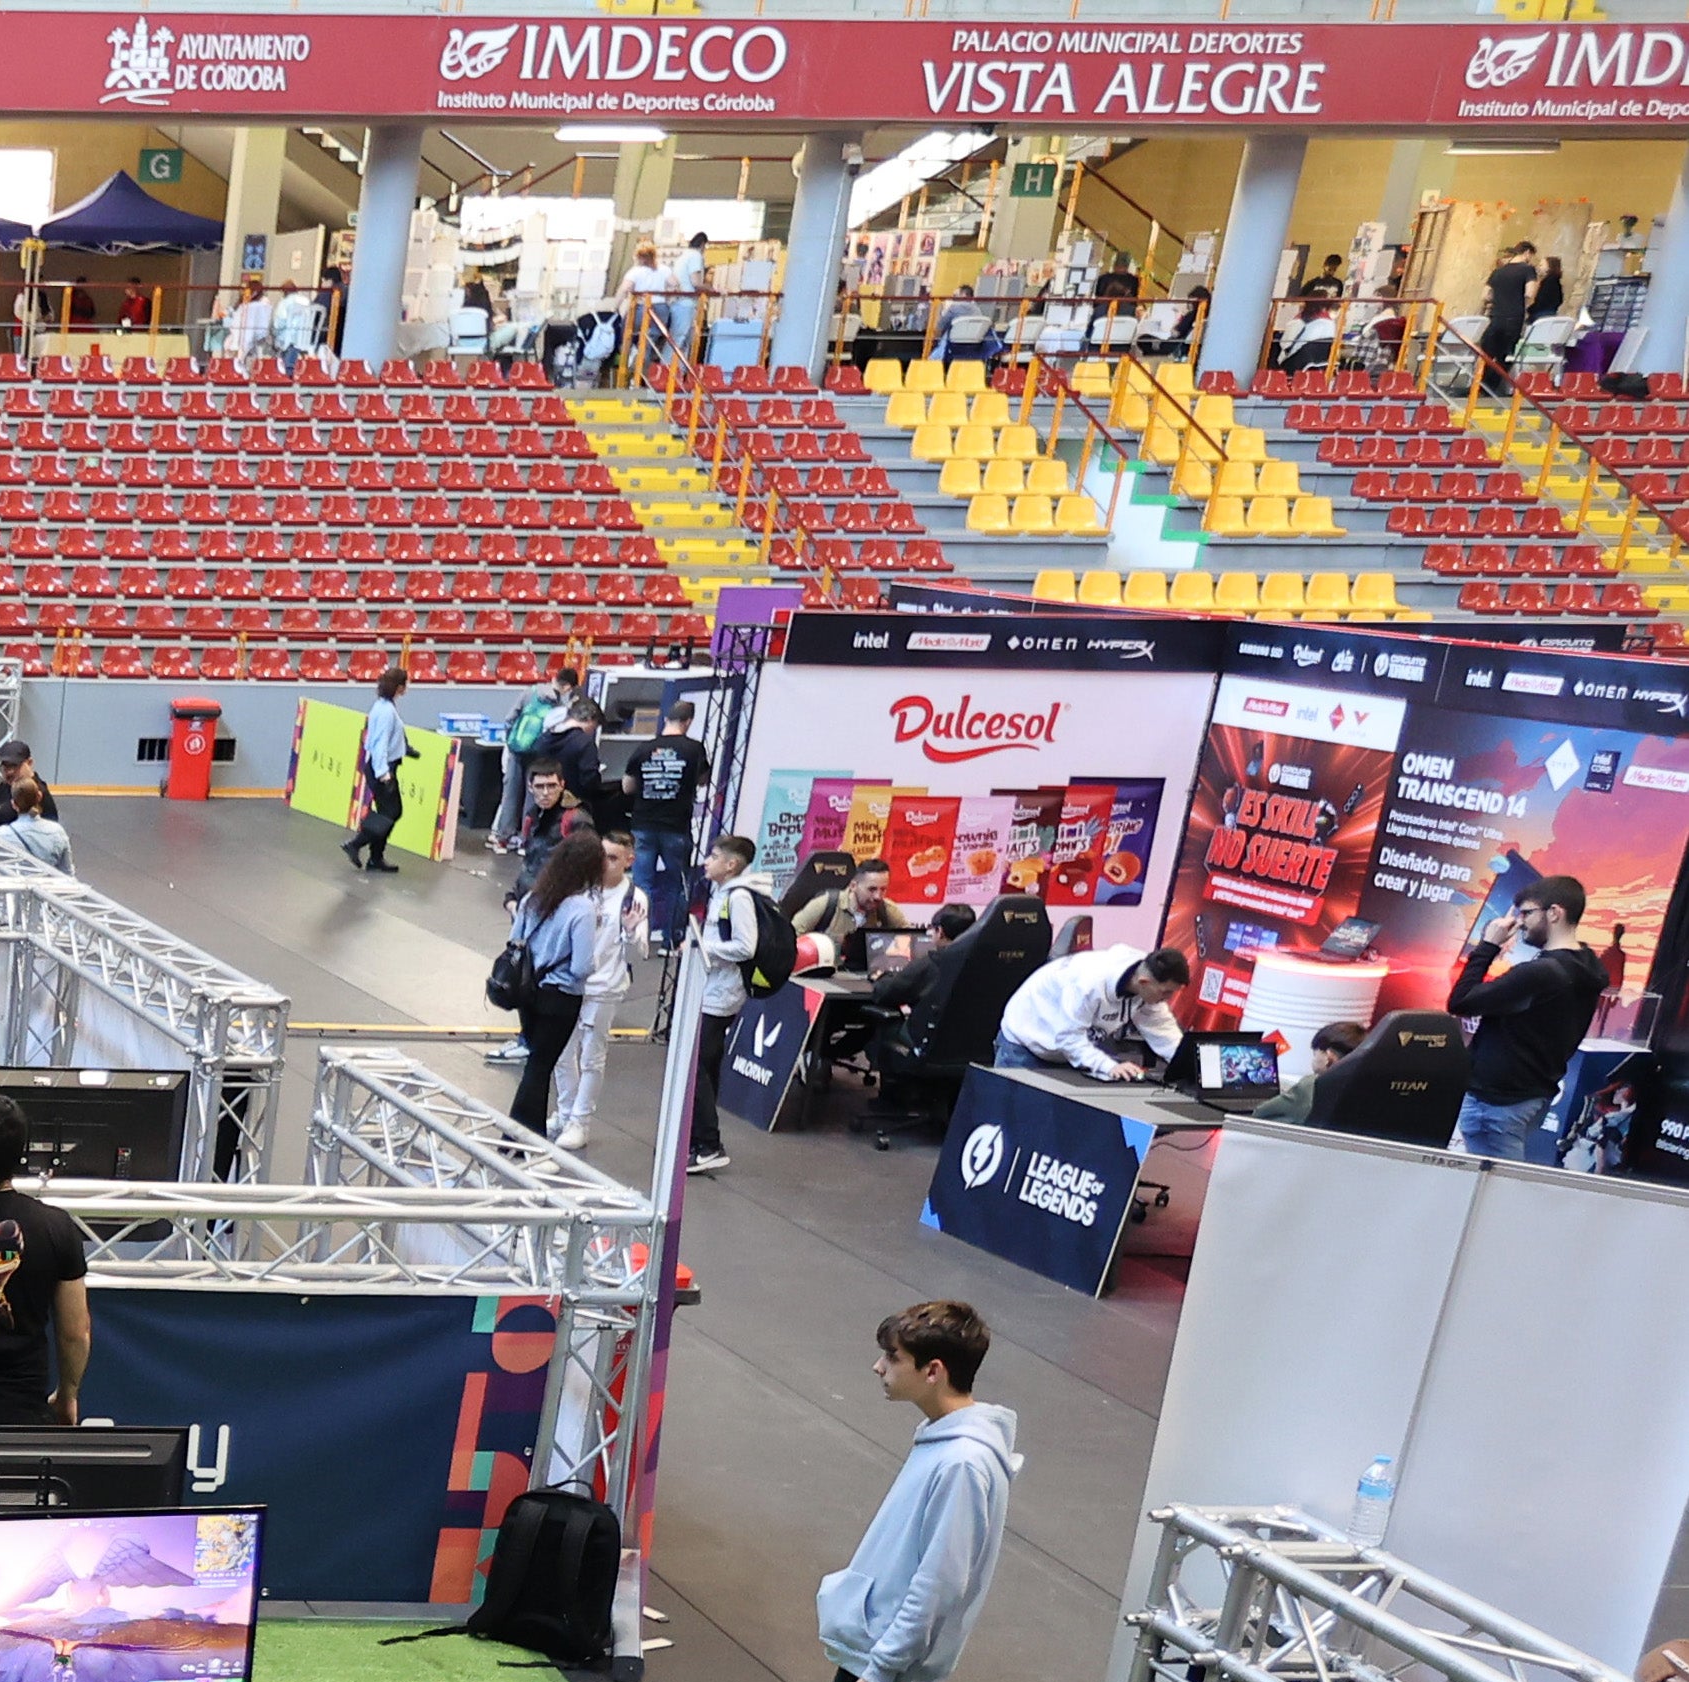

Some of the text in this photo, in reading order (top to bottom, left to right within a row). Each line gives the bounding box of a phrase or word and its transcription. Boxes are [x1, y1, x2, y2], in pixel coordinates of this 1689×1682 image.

[177, 33, 311, 62] AYUNTAMIENTO
[518, 24, 788, 83] IMDECO
[952, 30, 1303, 55] PALACIO MUNICIPAL DEPORTES
[1545, 31, 1689, 88] IMD
[174, 61, 288, 92] DE CÓRDOBA
[921, 61, 1326, 115] VISTA ALEGRE
[436, 90, 775, 114] Instituto Municipal de Deportes Córdoba
[1457, 98, 1689, 121] Instituto Municipal de Depo
[151, 152, 171, 180] G
[1023, 167, 1045, 192] H
[852, 631, 890, 650] intel
[1021, 637, 1079, 652] OMEN
[1087, 638, 1157, 662] HYPERX
[1465, 667, 1493, 689] intel
[1583, 684, 1628, 701] OMEN
[889, 693, 1062, 746] Dulcesol
[1401, 751, 1454, 780] OMEN
[1235, 786, 1322, 839] ES SKILL
[1397, 776, 1528, 820] TRANSCEND 14
[1205, 825, 1339, 891] NO SUERTE
[1378, 846, 1472, 883] Diseñado para
[1373, 870, 1408, 894] crear
[1418, 880, 1455, 904] jugar
[1389, 1080, 1429, 1092] TITAN
[1660, 1118, 1685, 1141] 990
[1026, 1151, 1107, 1199] LEAGUE OF
[1018, 1176, 1100, 1228] LEGENDS
